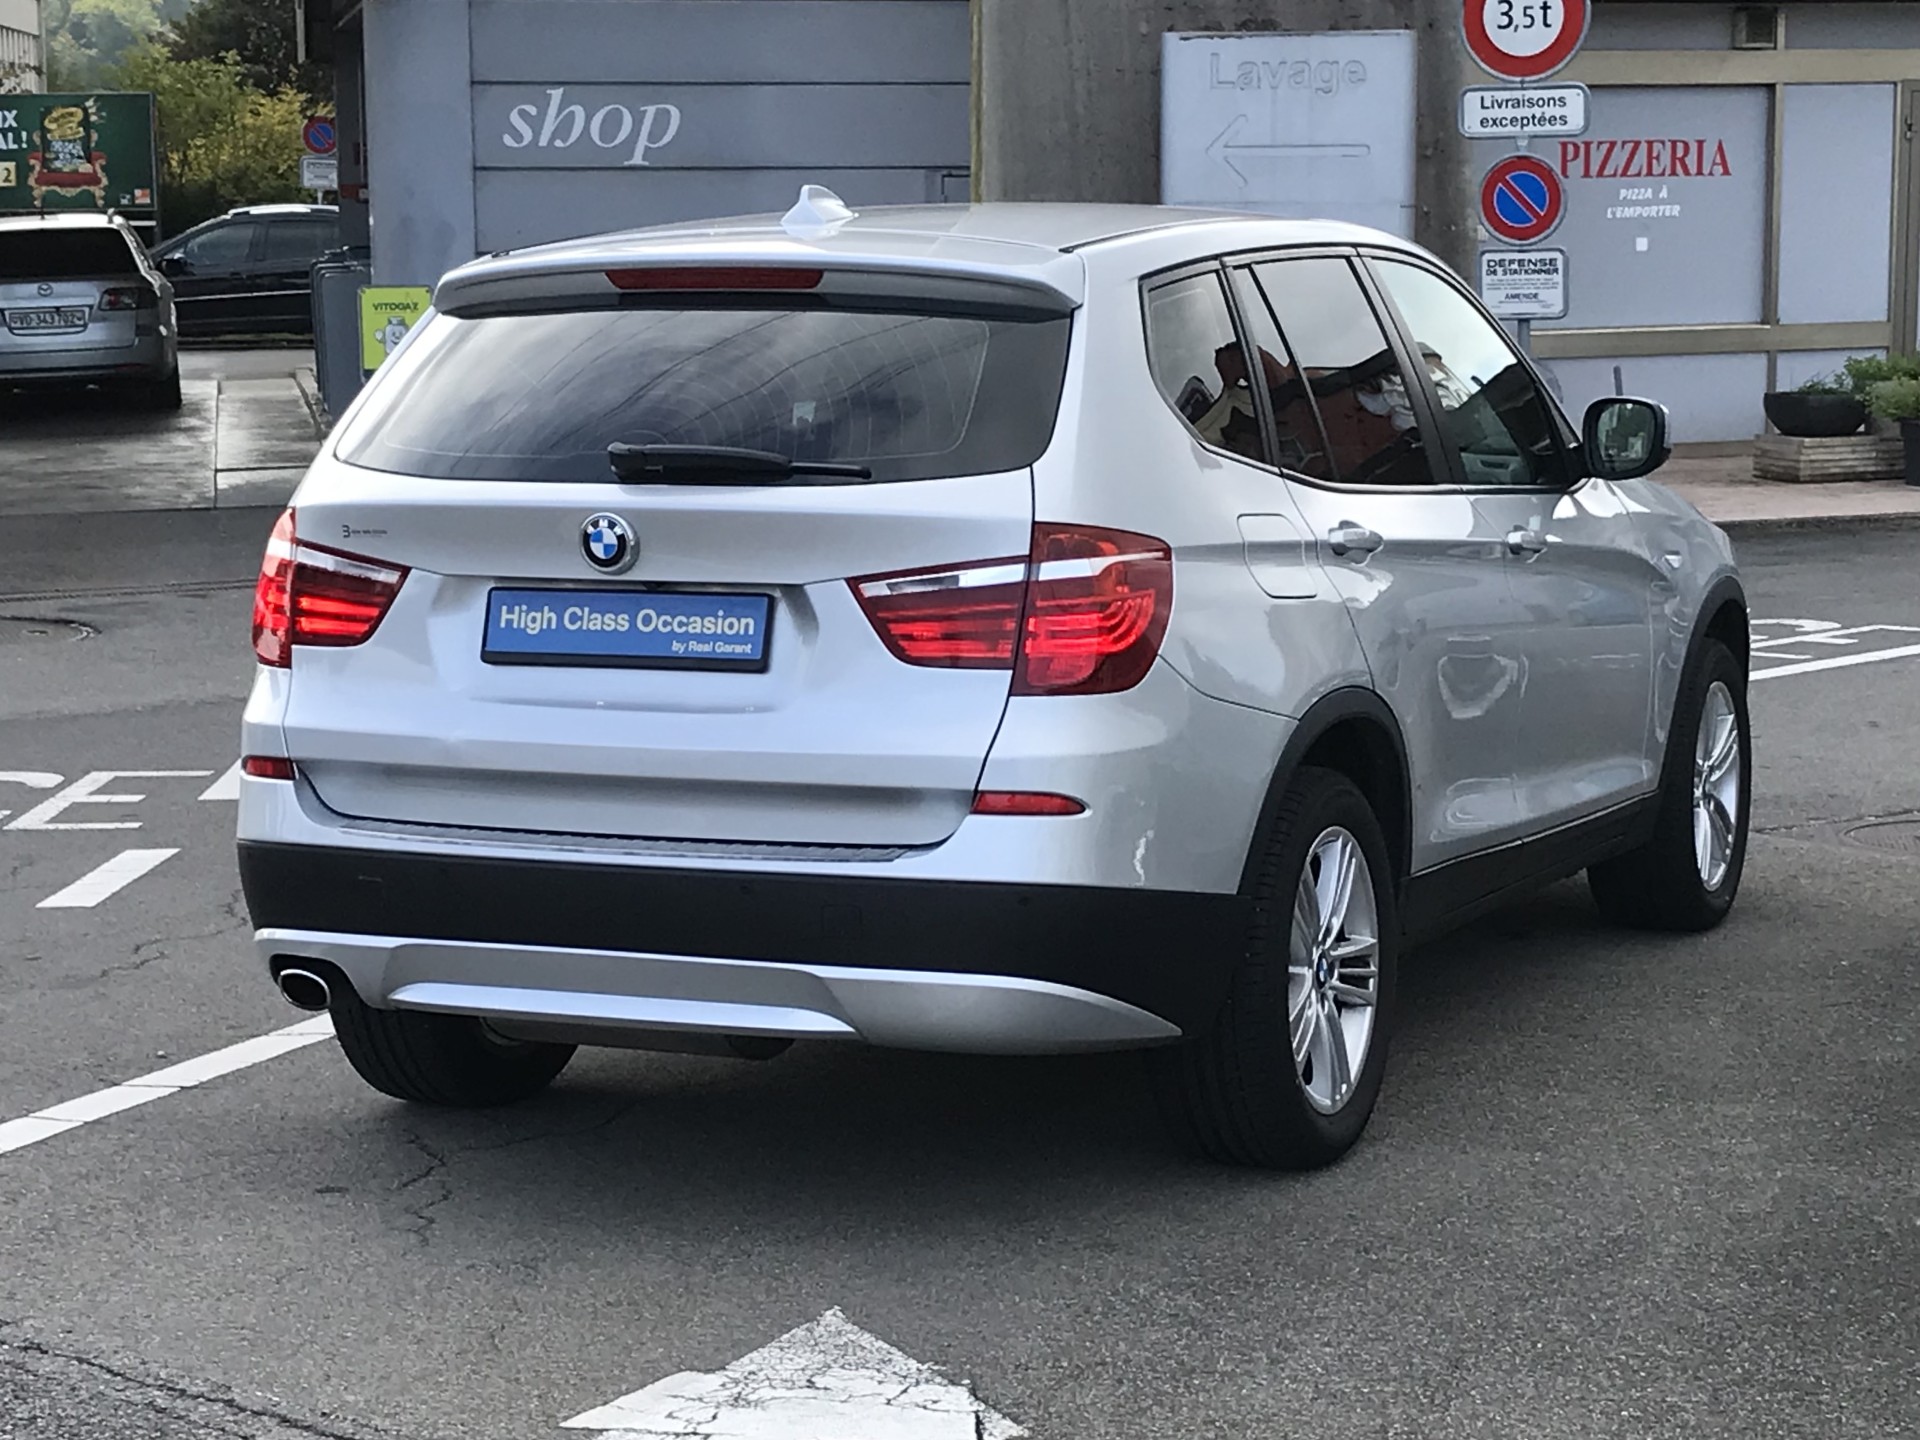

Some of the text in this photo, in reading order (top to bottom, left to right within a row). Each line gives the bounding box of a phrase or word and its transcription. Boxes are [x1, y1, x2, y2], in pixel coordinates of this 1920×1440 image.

[1210, 52, 1367, 97] Lavage
[1480, 94, 1567, 110] Livraisons
[502, 87, 681, 165] shop
[1480, 112, 1568, 130] exceptées
[1558, 138, 1732, 179] PIZZERIA
[1619, 184, 1668, 201] PIZZA À
[1606, 204, 1681, 219] L'EMPORTER
[1485, 267, 1559, 276] DE STATIONNER
[1504, 292, 1540, 300] AMENDE
[372, 302, 419, 311] VITOGAZ
[586, 518, 624, 536] BMW
[500, 605, 755, 635] High Class Occasion
[672, 640, 752, 654] by Real Garant
